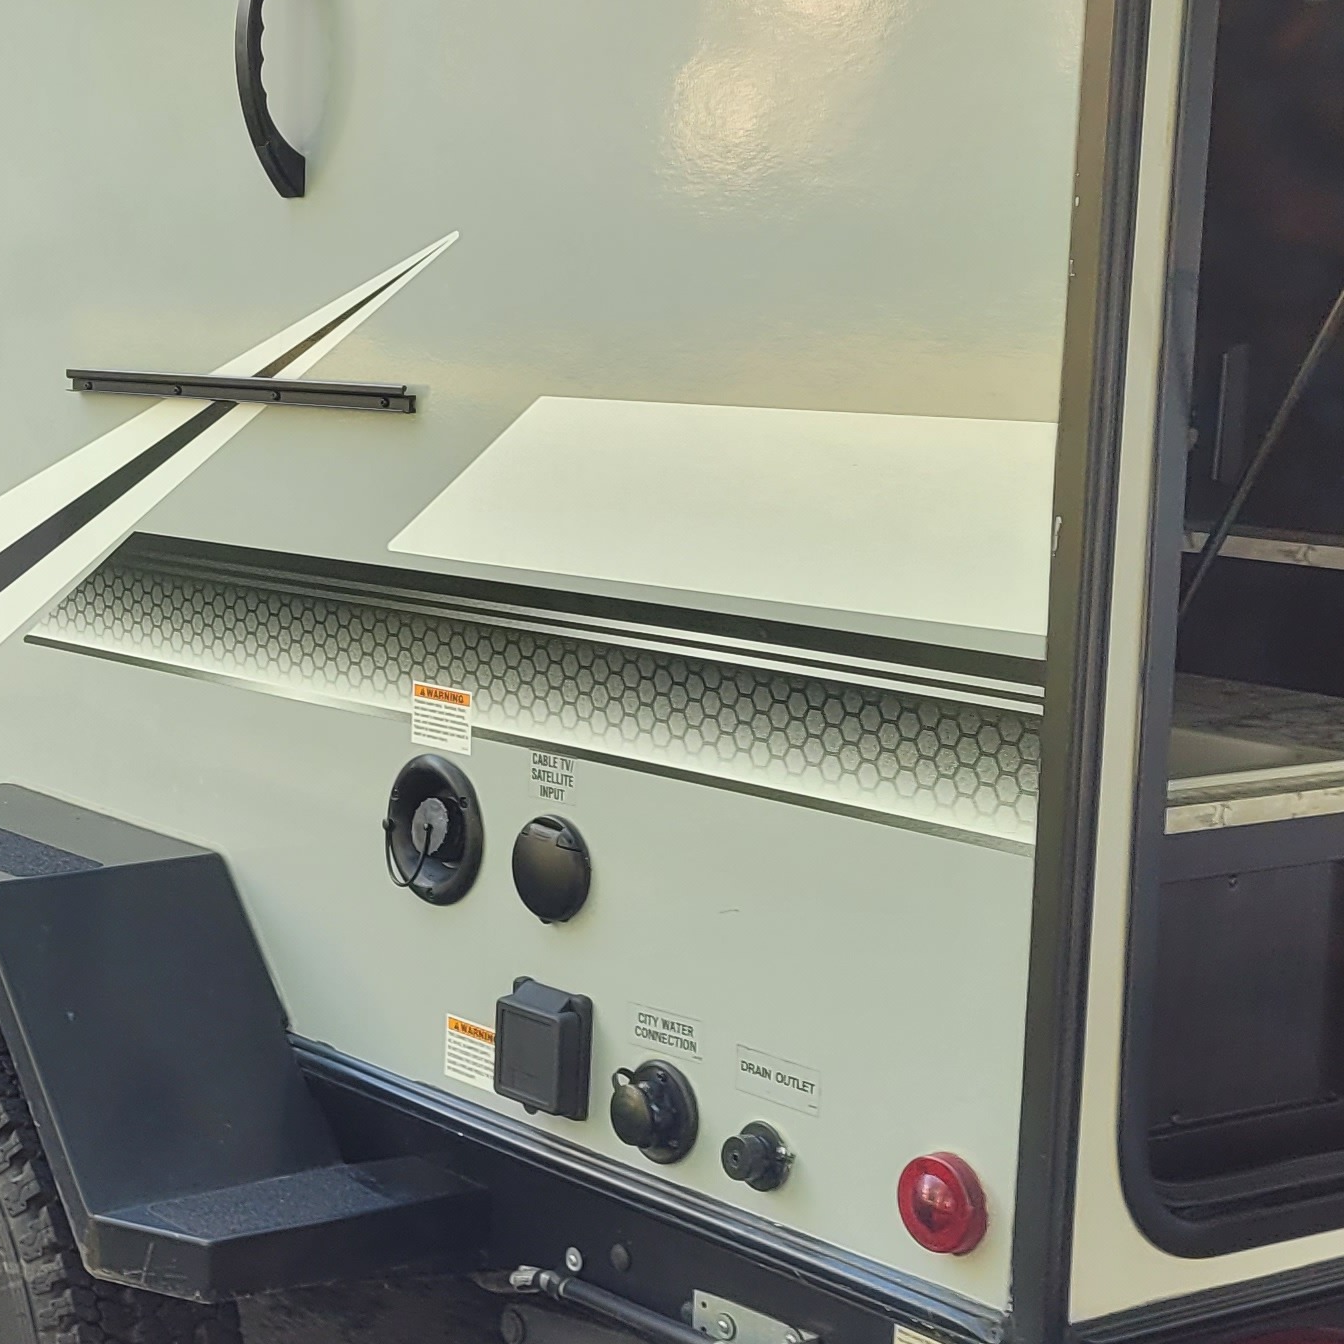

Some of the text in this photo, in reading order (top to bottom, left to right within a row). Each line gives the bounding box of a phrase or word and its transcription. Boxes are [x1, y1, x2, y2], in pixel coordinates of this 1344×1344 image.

[426, 688, 464, 704] WARNING
[532, 752, 574, 773] CABLE TV/
[531, 767, 574, 788] SATELLITE
[539, 784, 565, 801] INPUT
[638, 1012, 694, 1038] CITY WATER
[635, 1025, 697, 1053] CONNECTION
[740, 1060, 815, 1095] DRAIN OUTLET
